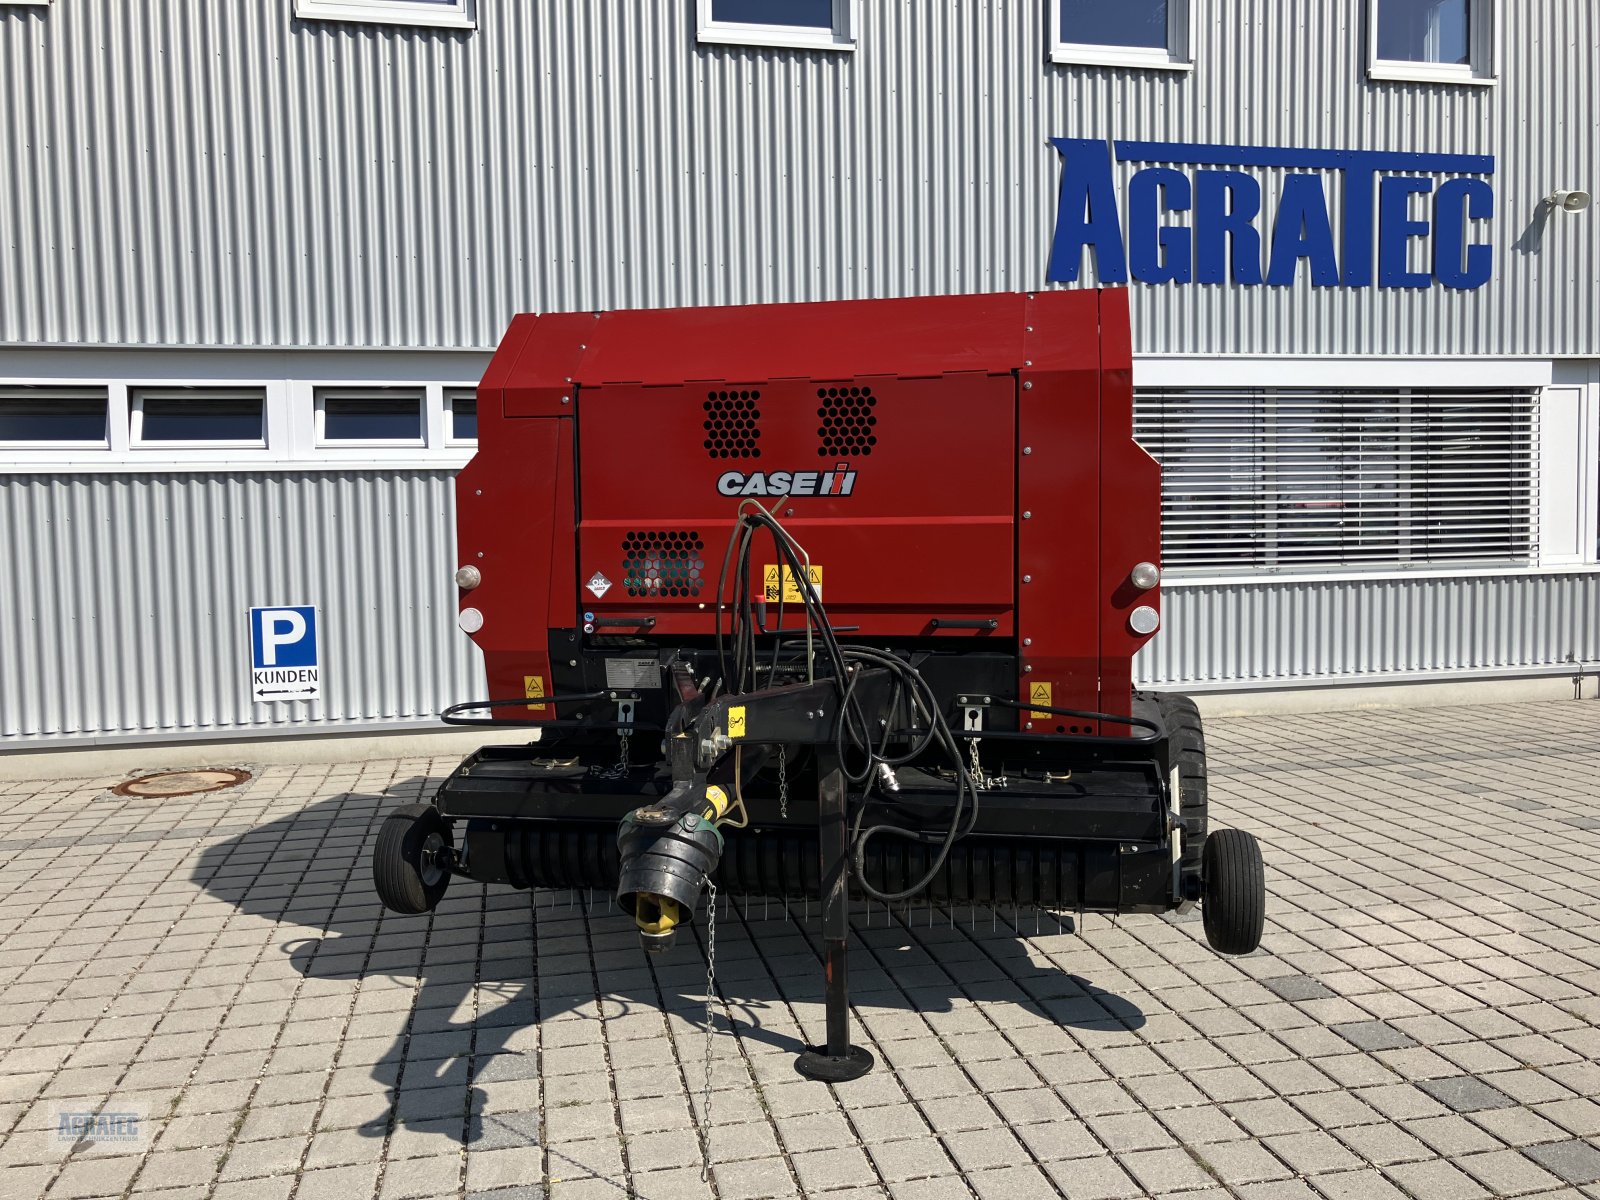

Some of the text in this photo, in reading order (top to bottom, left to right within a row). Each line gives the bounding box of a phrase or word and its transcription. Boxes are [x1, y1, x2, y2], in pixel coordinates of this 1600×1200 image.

[1046, 136, 1495, 290] AGRATEC
[717, 471, 818, 496] CASE
[261, 609, 307, 666] P
[254, 669, 318, 685] KUNDEN
